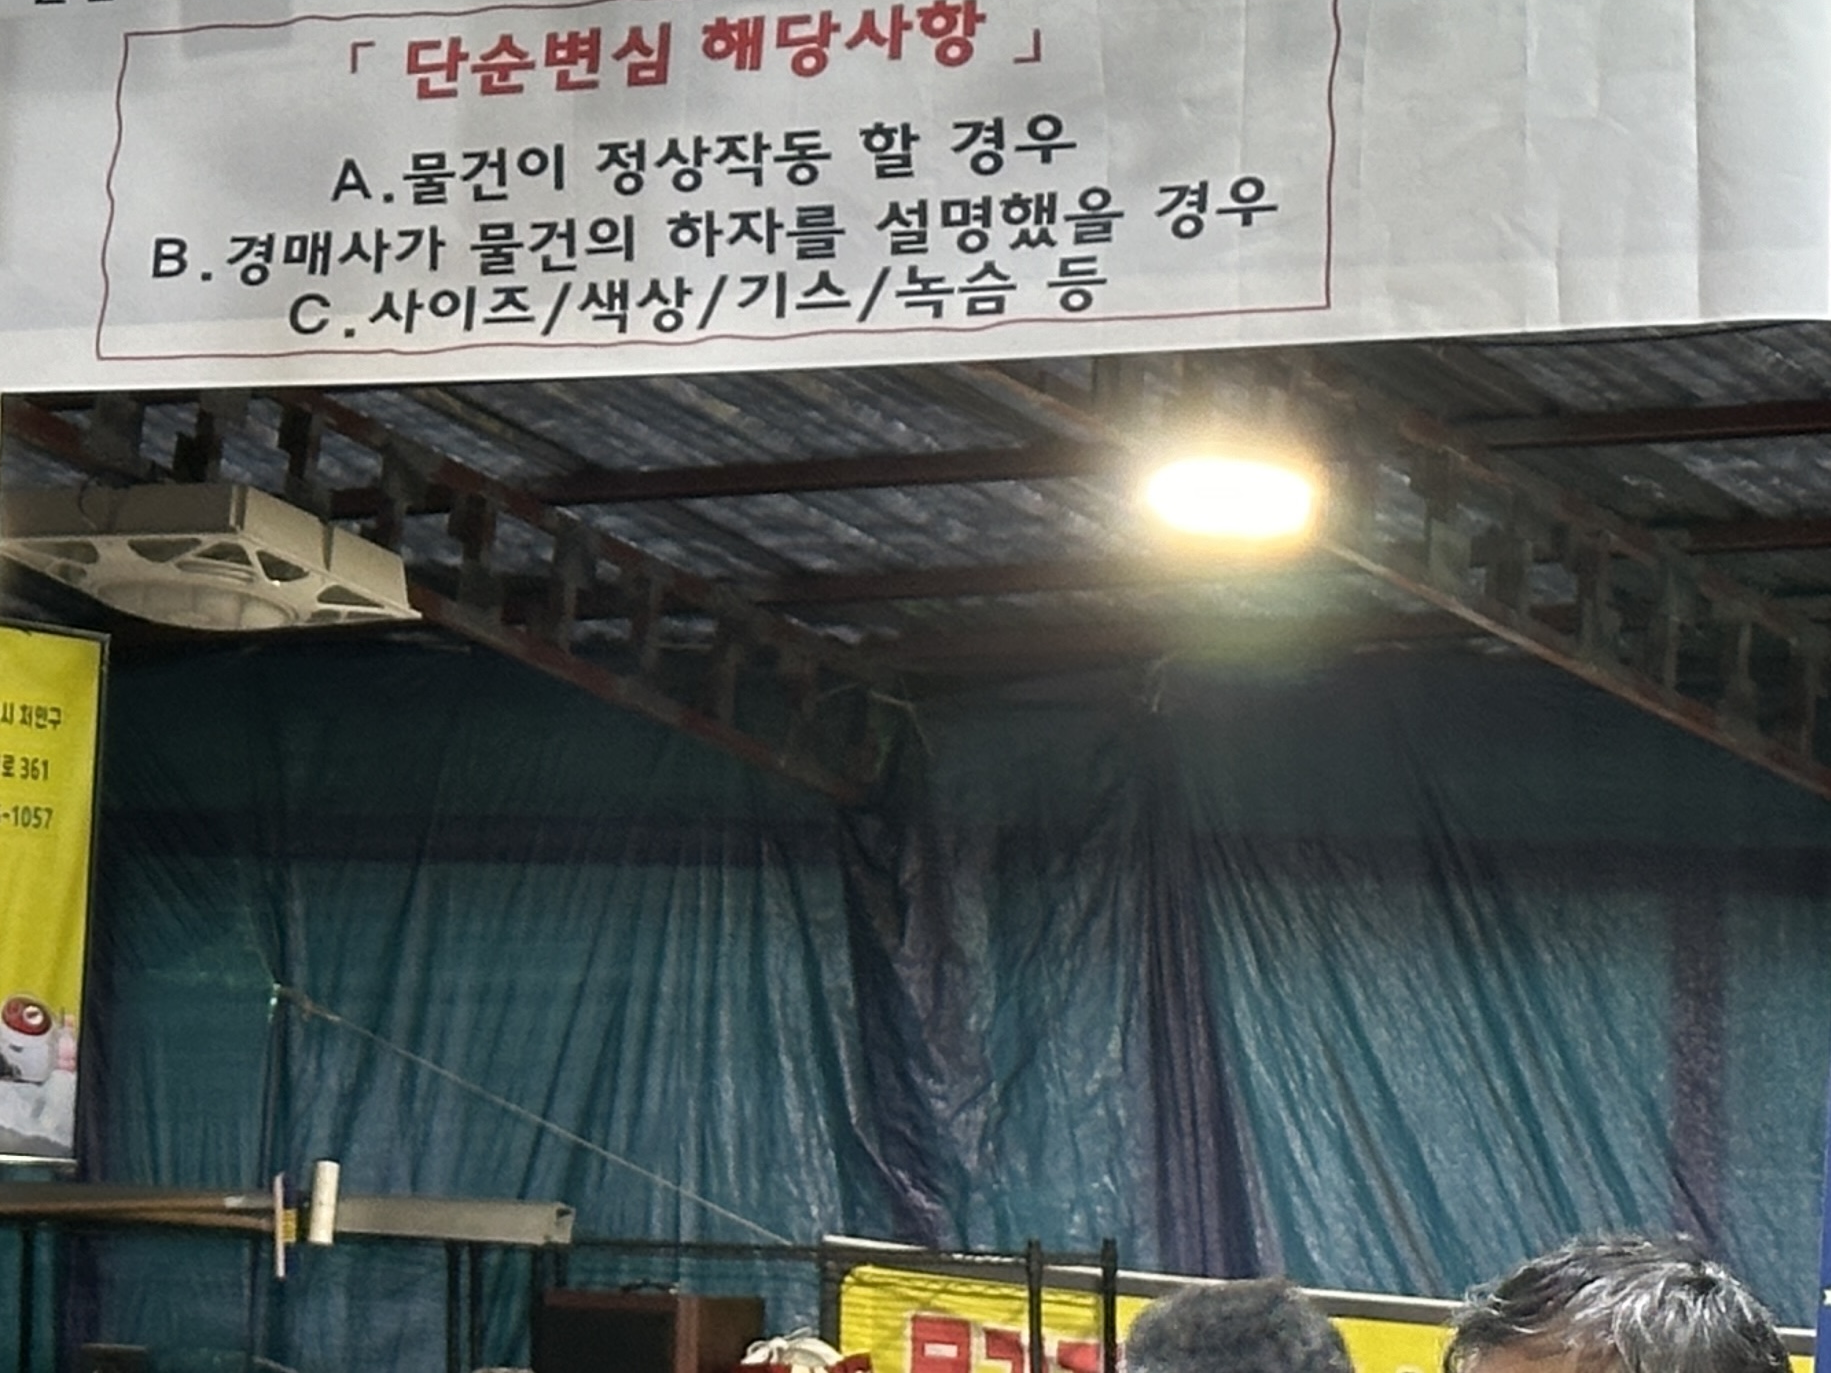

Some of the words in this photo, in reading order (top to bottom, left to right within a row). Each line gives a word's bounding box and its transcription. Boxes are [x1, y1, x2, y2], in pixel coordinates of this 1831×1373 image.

[406, 22, 671, 100] 단순변심
[596, 130, 832, 196] 정상작동
[859, 122, 921, 180] 할
[951, 114, 1077, 176] 경우
[470, 214, 634, 276] 물건의
[666, 204, 846, 260] 하자를
[875, 186, 1125, 256] 설명했을
[1155, 177, 1278, 239] 경우
[1047, 255, 1107, 313] 등
[21, 757, 48, 780] 361
